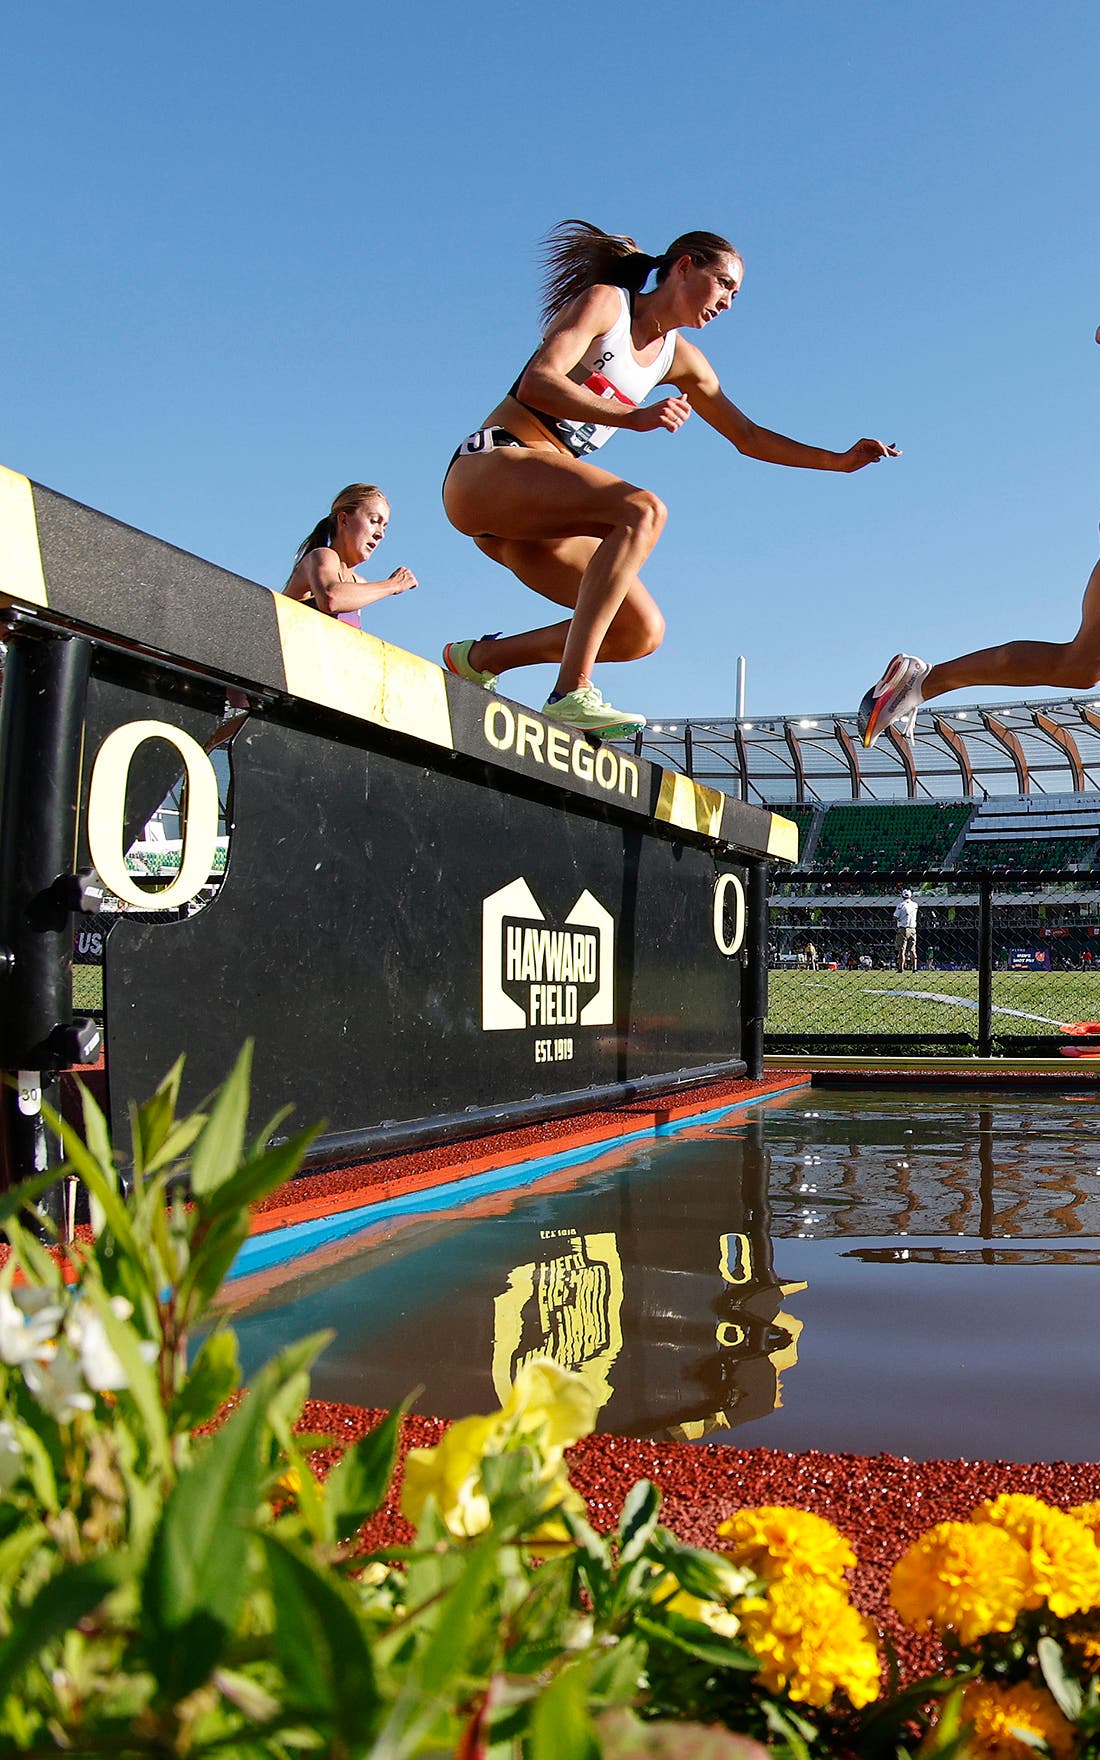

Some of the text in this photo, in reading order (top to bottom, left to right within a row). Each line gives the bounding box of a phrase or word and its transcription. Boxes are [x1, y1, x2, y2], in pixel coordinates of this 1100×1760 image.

[484, 701, 640, 798] OREGON
[79, 933, 103, 955] US
[506, 925, 597, 983] HAYWARD
[530, 984, 578, 1026] FIELD
[22, 1088, 38, 1101] 30
